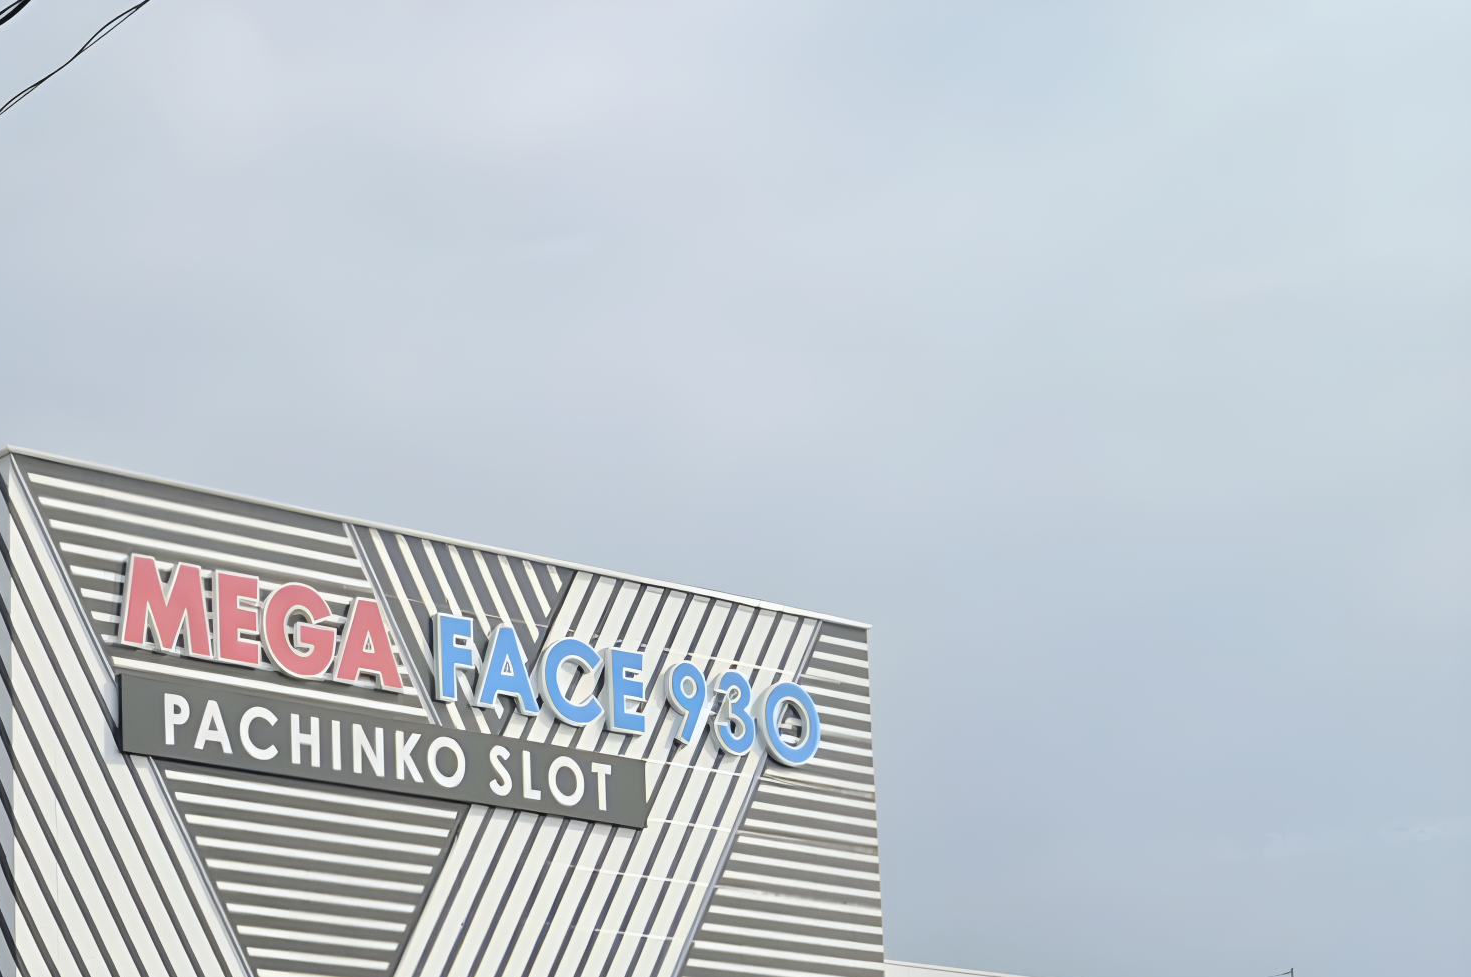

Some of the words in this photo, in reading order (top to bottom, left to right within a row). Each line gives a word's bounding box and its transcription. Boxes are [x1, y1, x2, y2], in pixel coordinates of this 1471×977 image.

[123, 554, 403, 691] MEGA
[433, 611, 648, 735] FACE
[665, 661, 821, 767] 930
[163, 694, 467, 789] PACHINKO
[489, 751, 612, 811] SLOT
